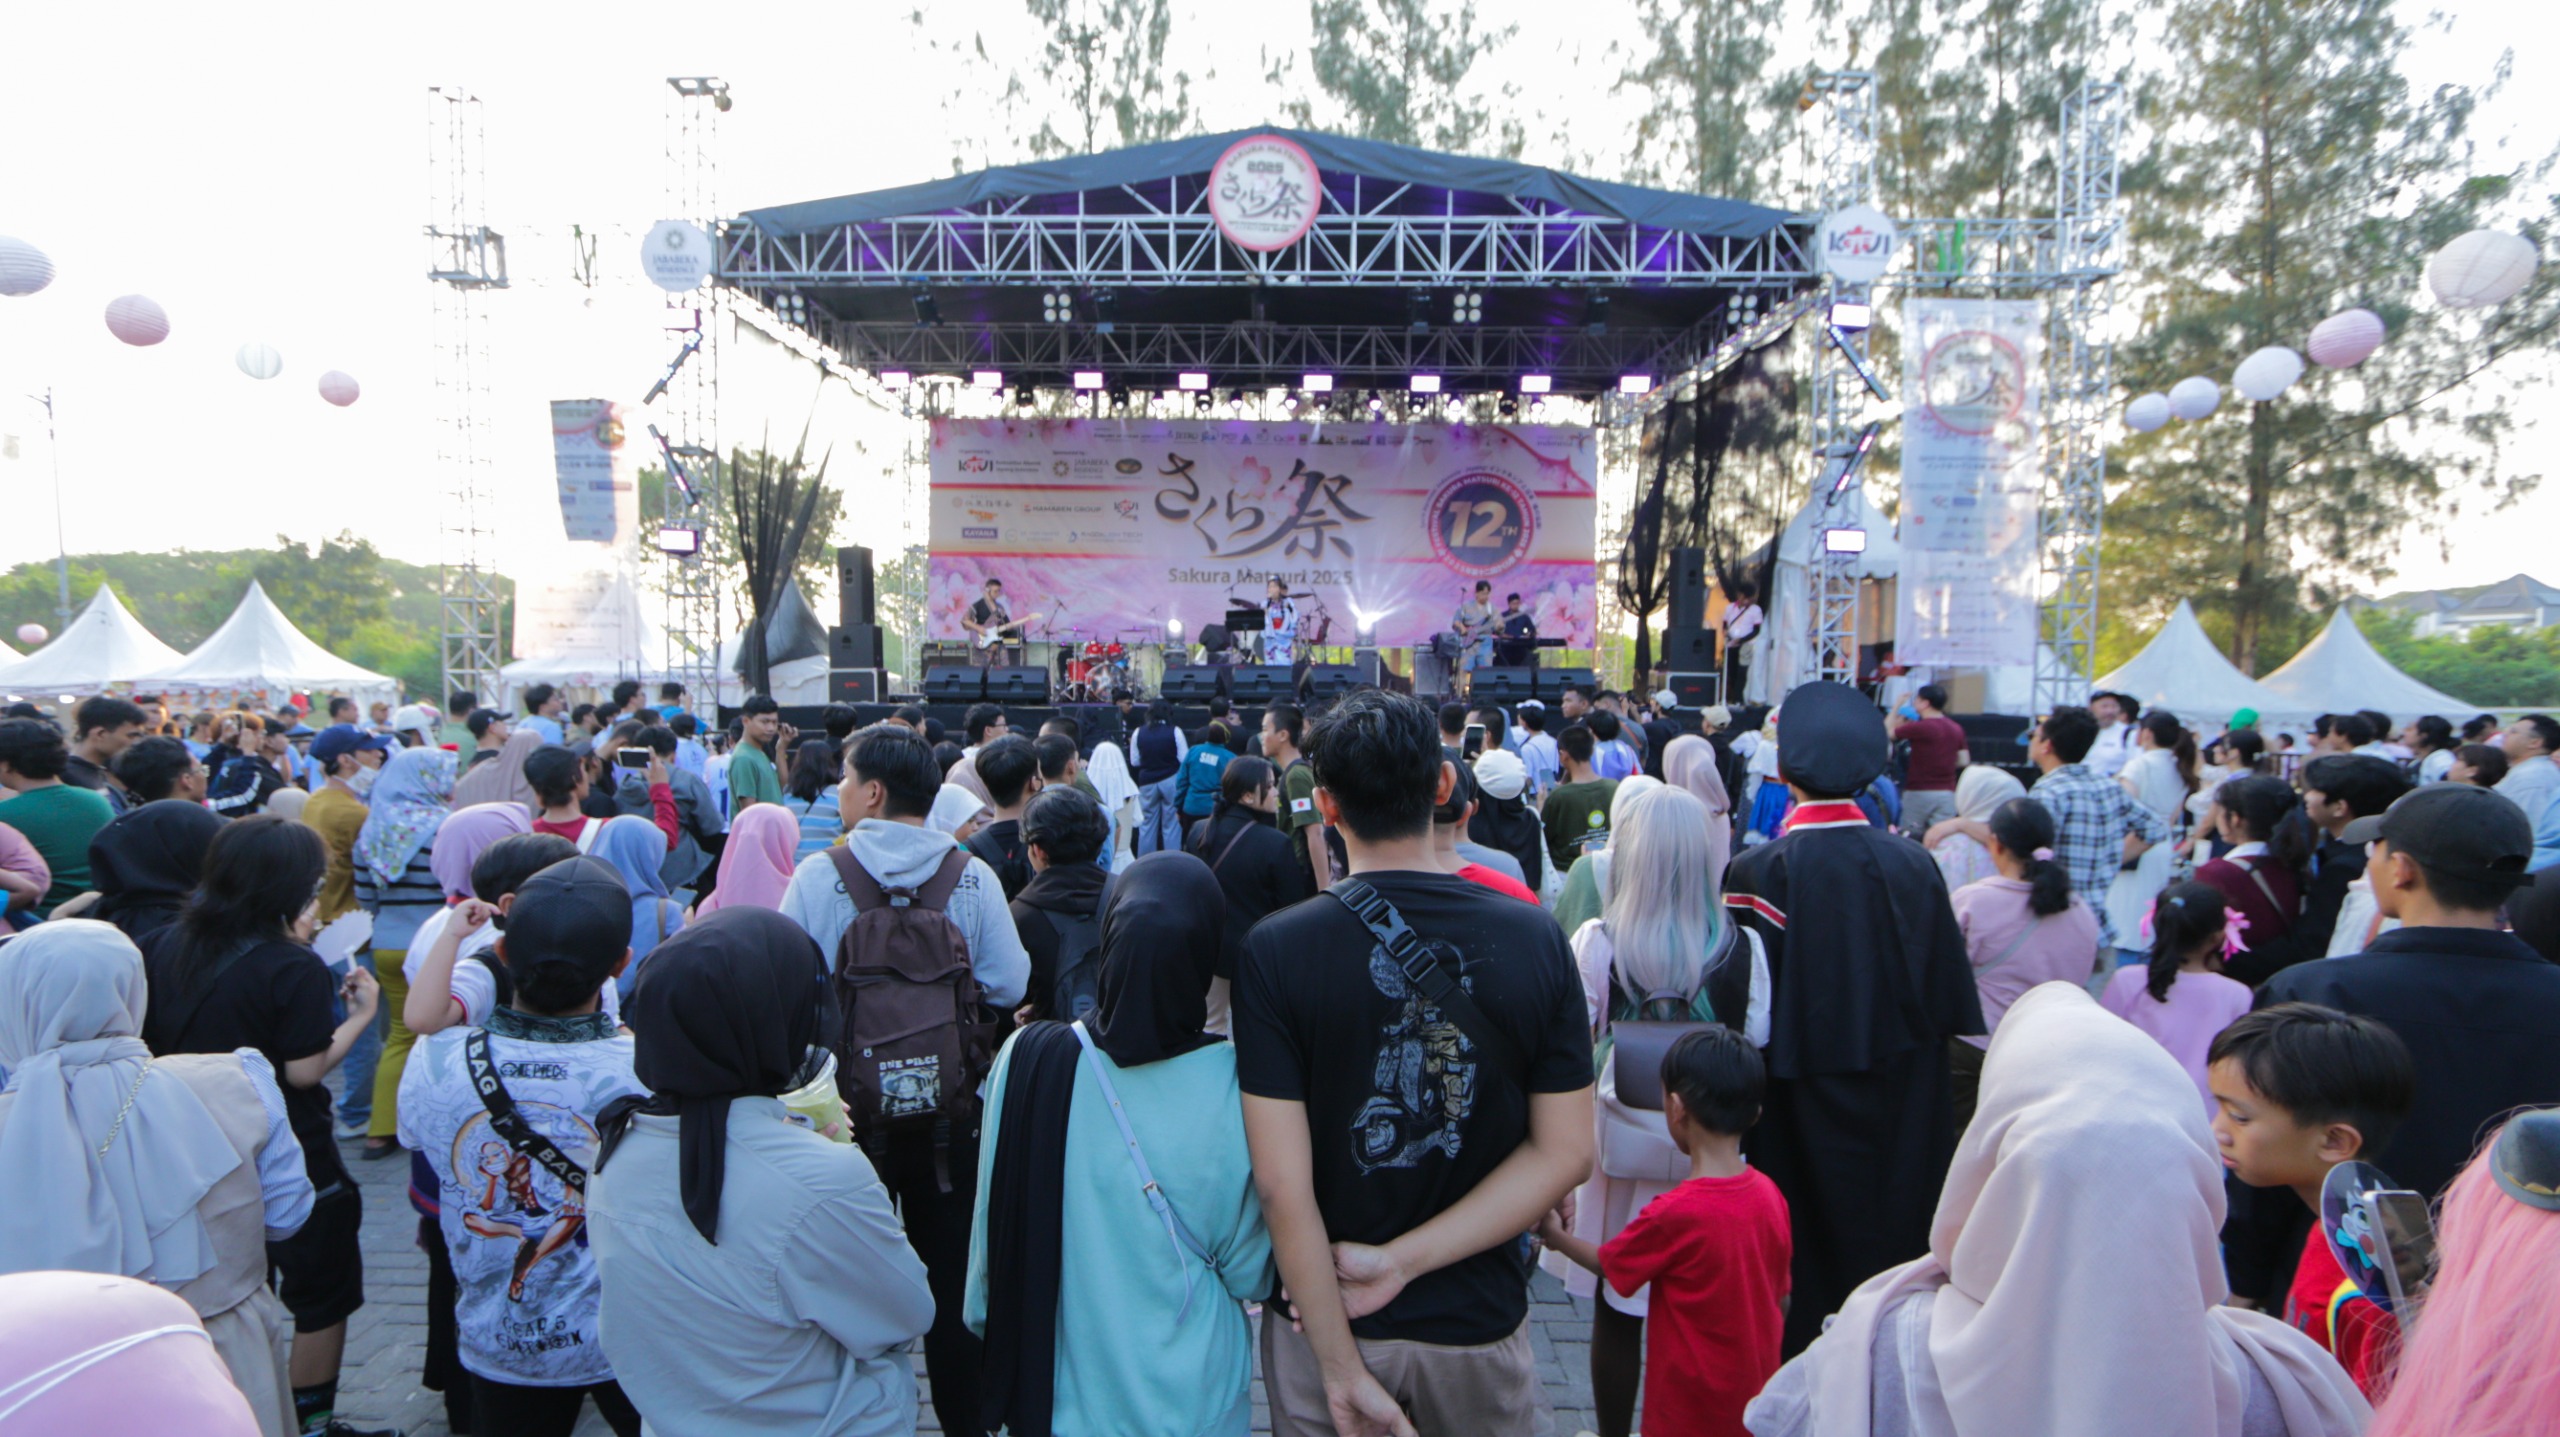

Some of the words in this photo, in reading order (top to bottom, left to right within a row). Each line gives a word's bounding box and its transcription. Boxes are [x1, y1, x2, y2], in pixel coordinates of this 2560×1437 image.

[1227, 145, 1264, 167] SAKURA
[1267, 145, 1306, 172] MATSURI
[1247, 161, 1284, 173] 2025
[1463, 476, 1501, 486] MATSURI
[1154, 452, 1374, 559] さくら祭
[1168, 568, 1231, 583] Sakura
[1311, 569, 1354, 584] 2025
[469, 1039, 498, 1096] BAG
[537, 1147, 586, 1186] BAG
[555, 1315, 567, 1331] 5
